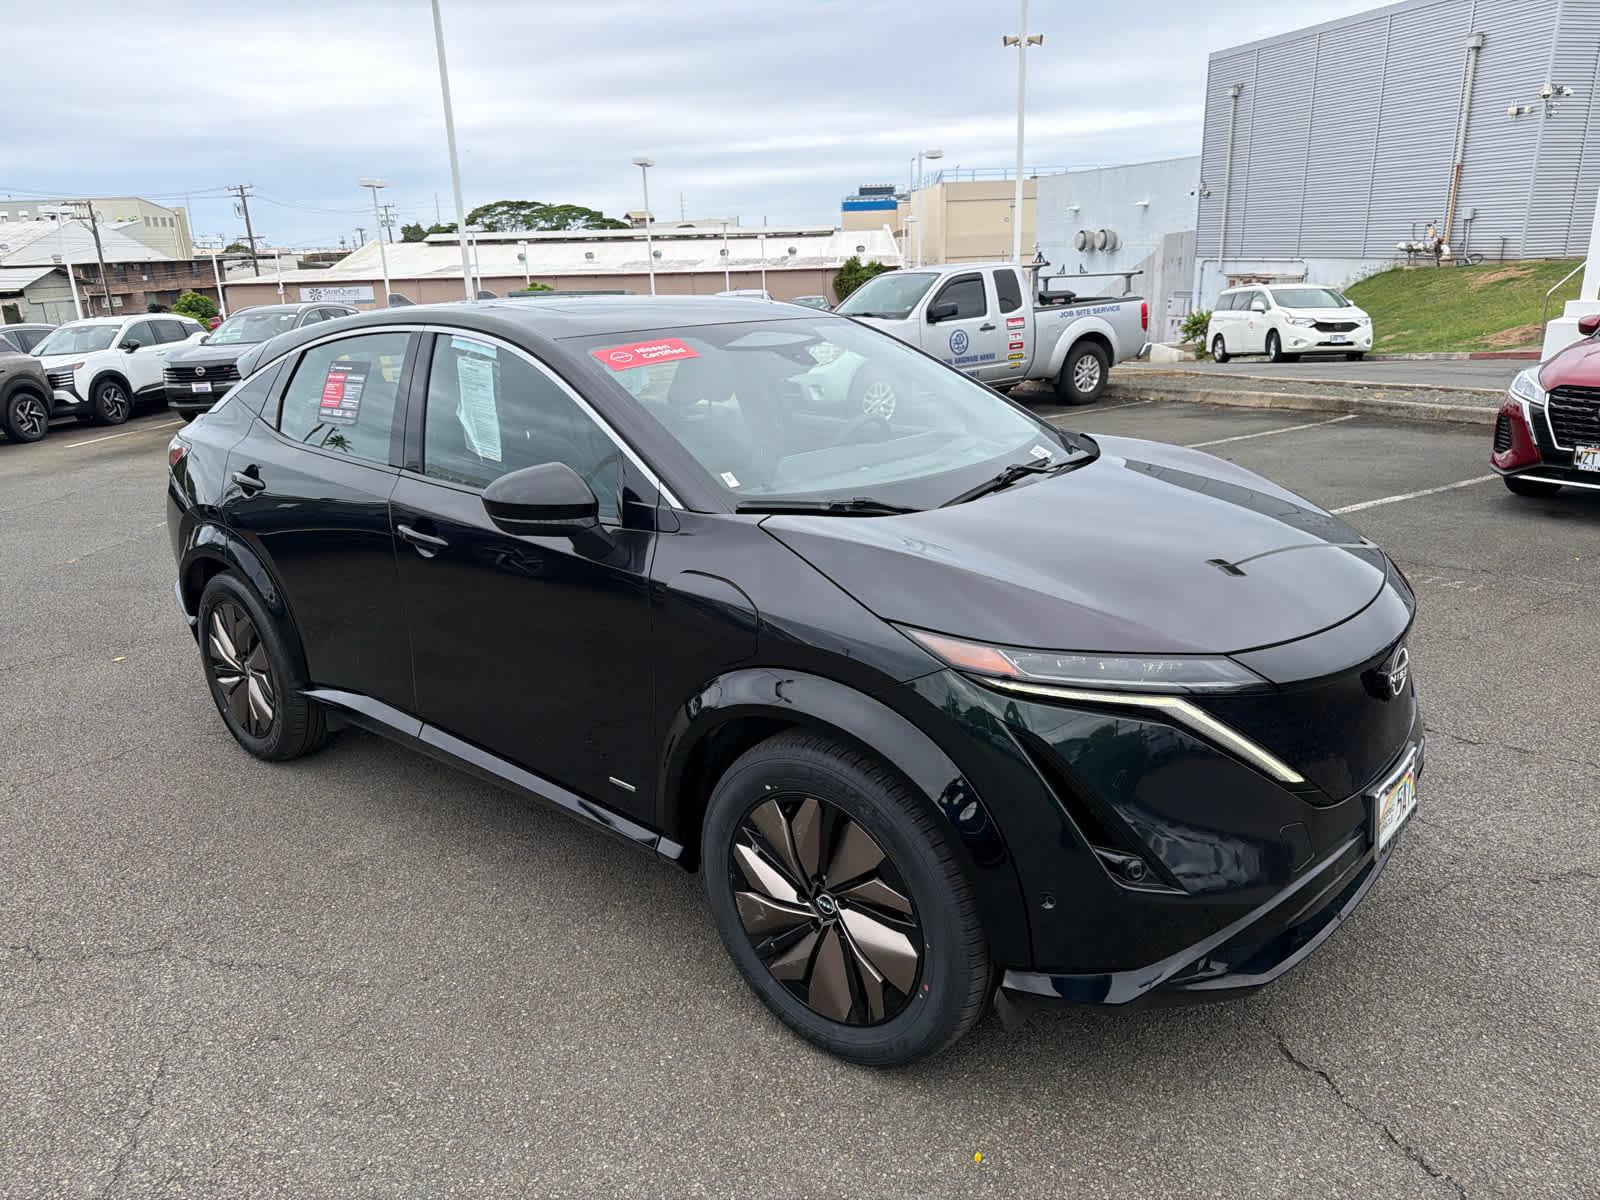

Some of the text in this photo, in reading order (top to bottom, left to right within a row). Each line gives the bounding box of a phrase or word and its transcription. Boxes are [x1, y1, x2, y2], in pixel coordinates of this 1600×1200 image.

[1059, 310, 1074, 318] JOB
[1092, 304, 1121, 314] SERVICE
[642, 348, 686, 358] Certified
